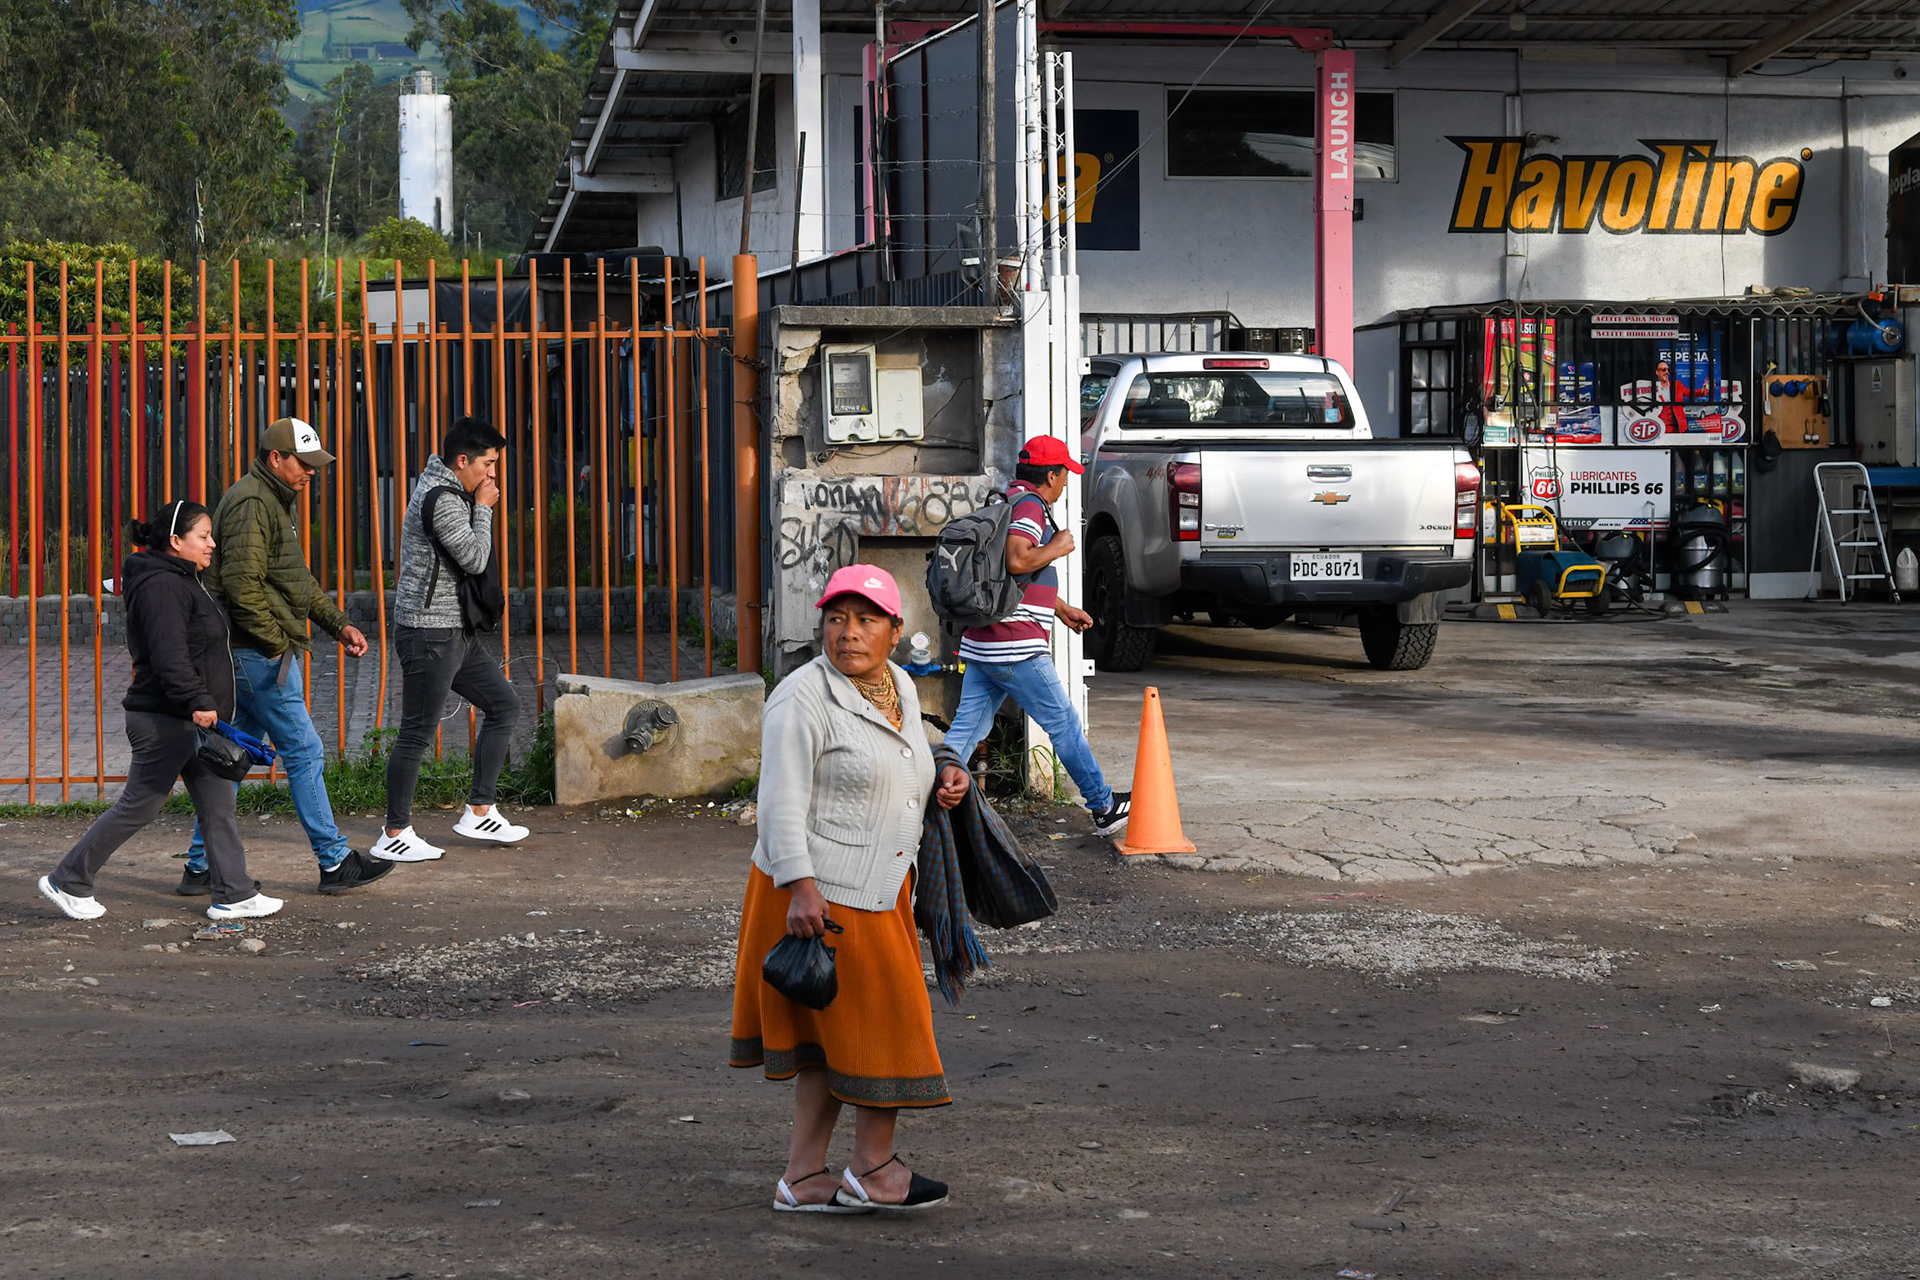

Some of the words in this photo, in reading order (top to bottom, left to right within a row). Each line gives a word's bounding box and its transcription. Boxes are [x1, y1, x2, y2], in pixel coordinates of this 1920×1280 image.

[1330, 72, 1349, 179] LAUNCH
[1446, 136, 1804, 236] Havoline
[1633, 421, 1656, 439] STP
[1721, 421, 1736, 438] TP
[1570, 471, 1637, 481] LUBRICANTES
[1536, 480, 1557, 495] 66
[1570, 482, 1640, 495] PHILLIPS
[1644, 482, 1664, 495] 66
[1561, 519, 1592, 527] TÉTICO
[1293, 562, 1359, 577] PDC-8071
